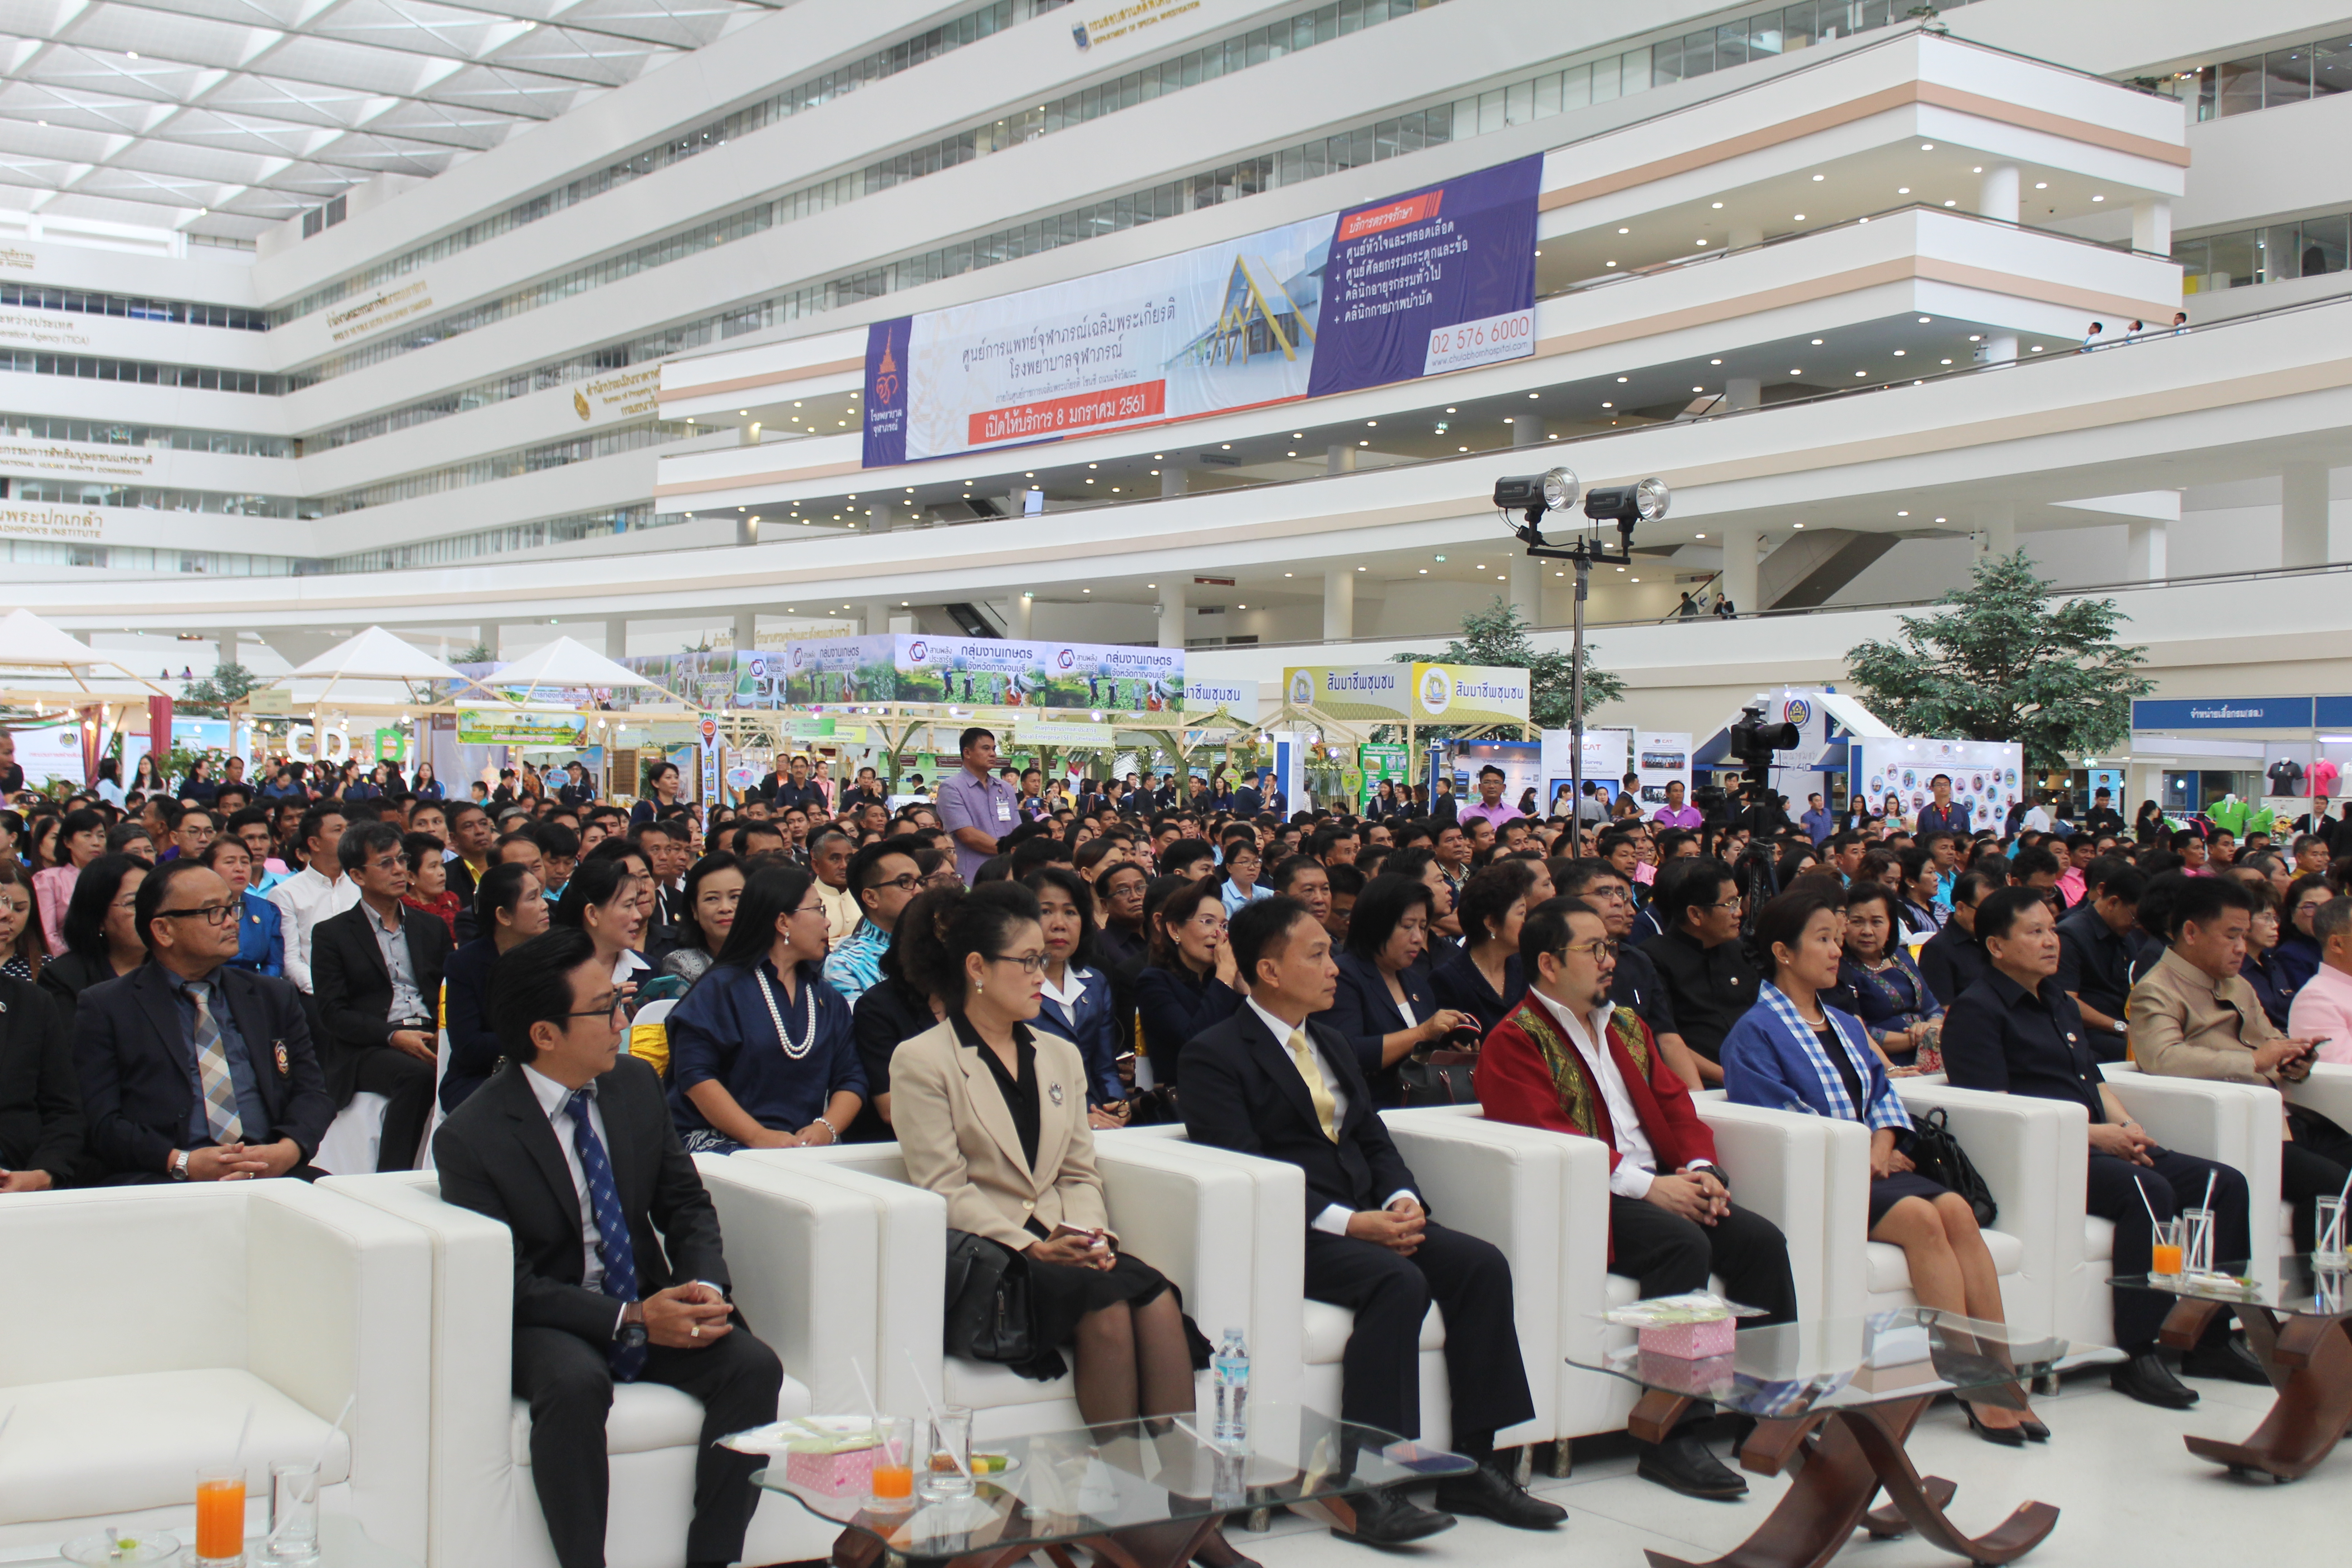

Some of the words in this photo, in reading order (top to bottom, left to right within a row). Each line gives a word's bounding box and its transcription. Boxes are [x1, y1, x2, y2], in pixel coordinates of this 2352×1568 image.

[1093, 27, 1127, 45] DEPARTMENT
[1137, 16, 1159, 29] SPECIAL
[1160, 1, 1200, 20] INVESTIGATION
[1349, 206, 1413, 233] บริการตรวจรักษา
[1346, 218, 1454, 265] ศูนย์หัวใจและหลอดเลือด
[1346, 234, 1468, 286] ศูนย์ศัลยกรรมกระดูกและข้อ
[1345, 262, 1441, 301] คลินิกอายุรกรรมทั่วไป
[1345, 289, 1433, 322] คลินิกกายภาพบำบัด
[962, 296, 1175, 372] ศูนย์การแพทย์จุฬาภรณ์เฉลิมพระเกียรติ
[1432, 333, 1449, 354] 02
[1457, 326, 1484, 349] 576
[1491, 316, 1529, 342] 6000
[1009, 334, 1123, 379] โรงพยาบาลจุฬาภรณ์
[1431, 341, 1527, 366] www.chulabhornhospital.com
[995, 379, 1080, 404] ภายในศูนย์ราชการเฉลิมพระเกียรติ
[1098, 369, 1137, 384] ถนนแจ้งวัฒนะ
[870, 409, 902, 422] โรงพยาบาล
[985, 408, 1053, 438] เปิดให้บริการ
[1056, 409, 1063, 425] 8
[1069, 401, 1116, 423] มกราคม
[1119, 394, 1146, 416] 2561
[873, 419, 898, 437] จุฬาภรณ์
[51, 528, 101, 538] INSTITUTE
[820, 646, 859, 662] กลุ่มงานเกษตร
[929, 655, 952, 666] ประชารัฐ
[930, 646, 952, 655] สานพลัง
[961, 643, 1033, 660] กลุ่มงานเกษตร
[1076, 654, 1098, 662] สานพลัง
[1106, 651, 1172, 666] กลุ่มงานเกษตร
[967, 661, 1025, 675] จังหวัดกาญจนบุรี
[1076, 662, 1098, 673] ประชารัฐ
[1112, 668, 1166, 681] จังหวัดกาญจนบุรี
[1183, 683, 1240, 706] มาชีพชุมชน
[1327, 671, 1394, 695] สัมมาชีพชุมชน
[1455, 681, 1524, 703] สัมมาชีพชุมชน
